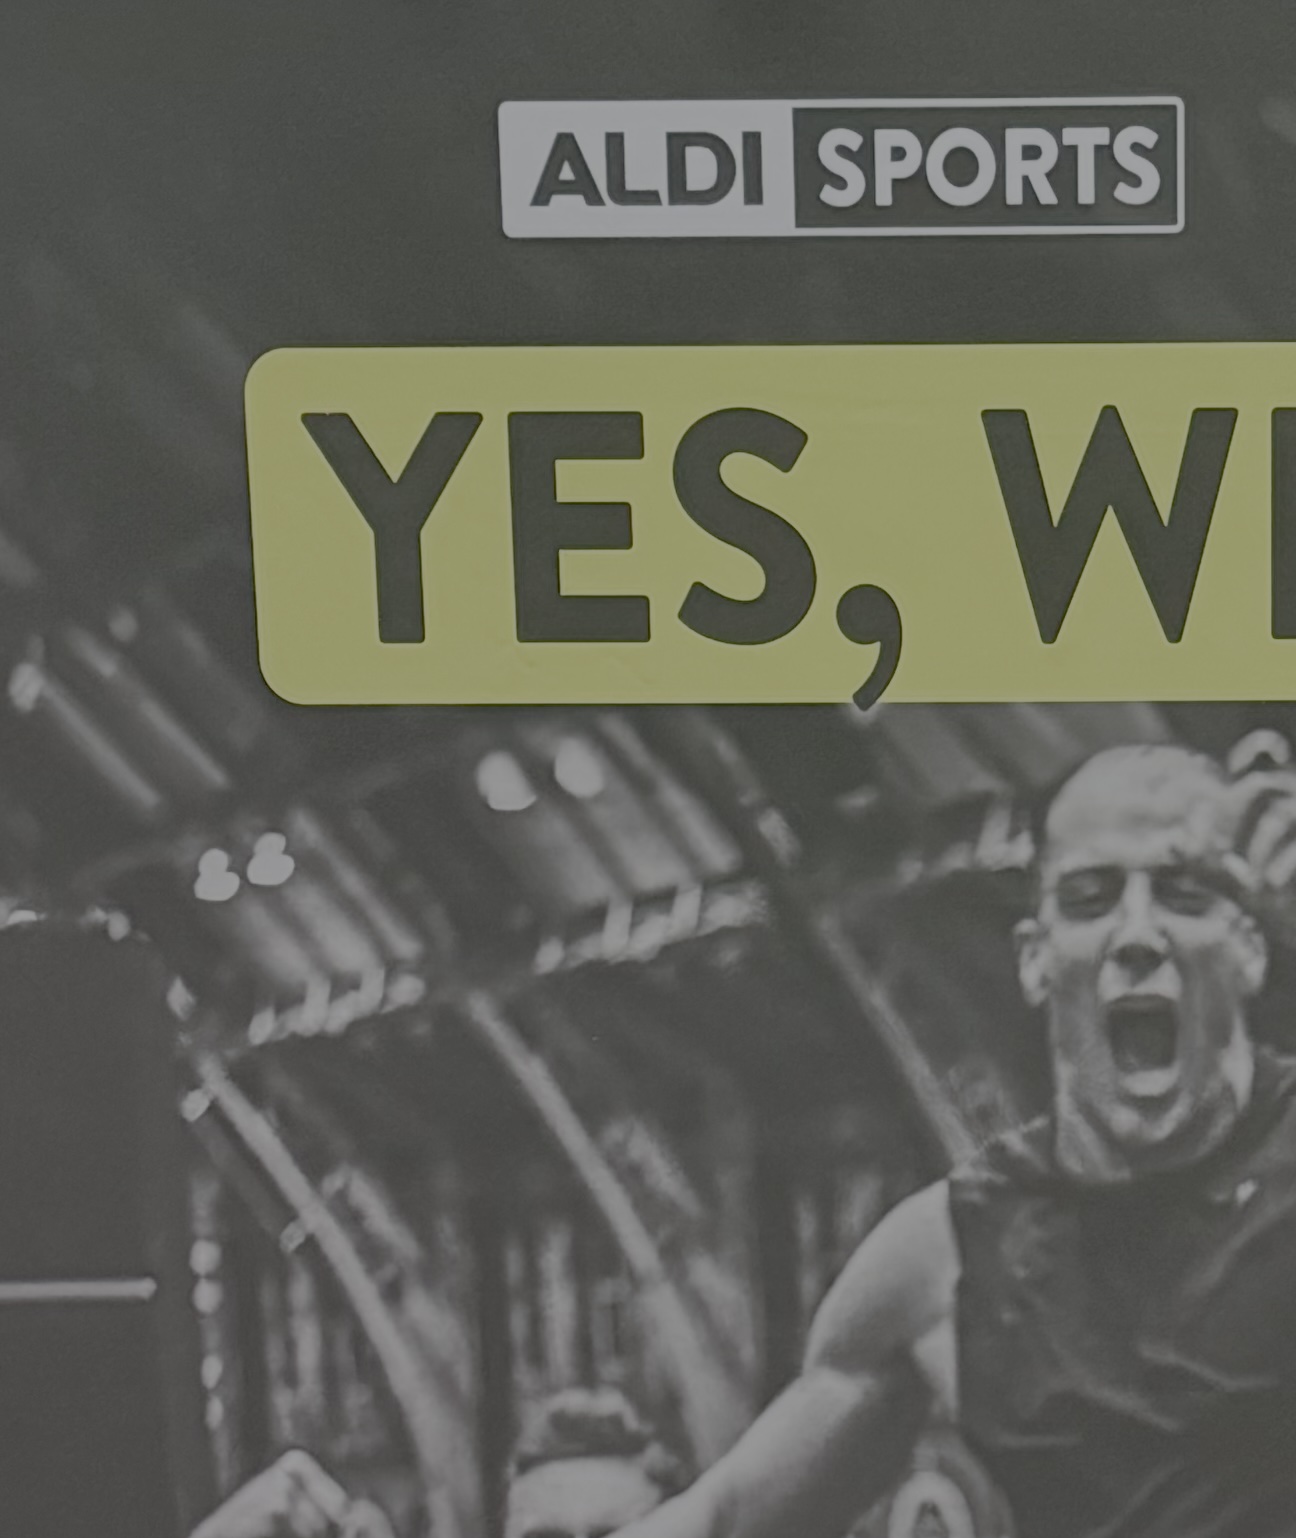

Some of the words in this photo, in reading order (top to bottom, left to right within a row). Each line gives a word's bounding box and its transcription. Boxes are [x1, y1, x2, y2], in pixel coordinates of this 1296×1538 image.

[529, 131, 764, 207] ALDI
[817, 125, 1161, 208] SPORTS
[300, 407, 903, 712] YES,
